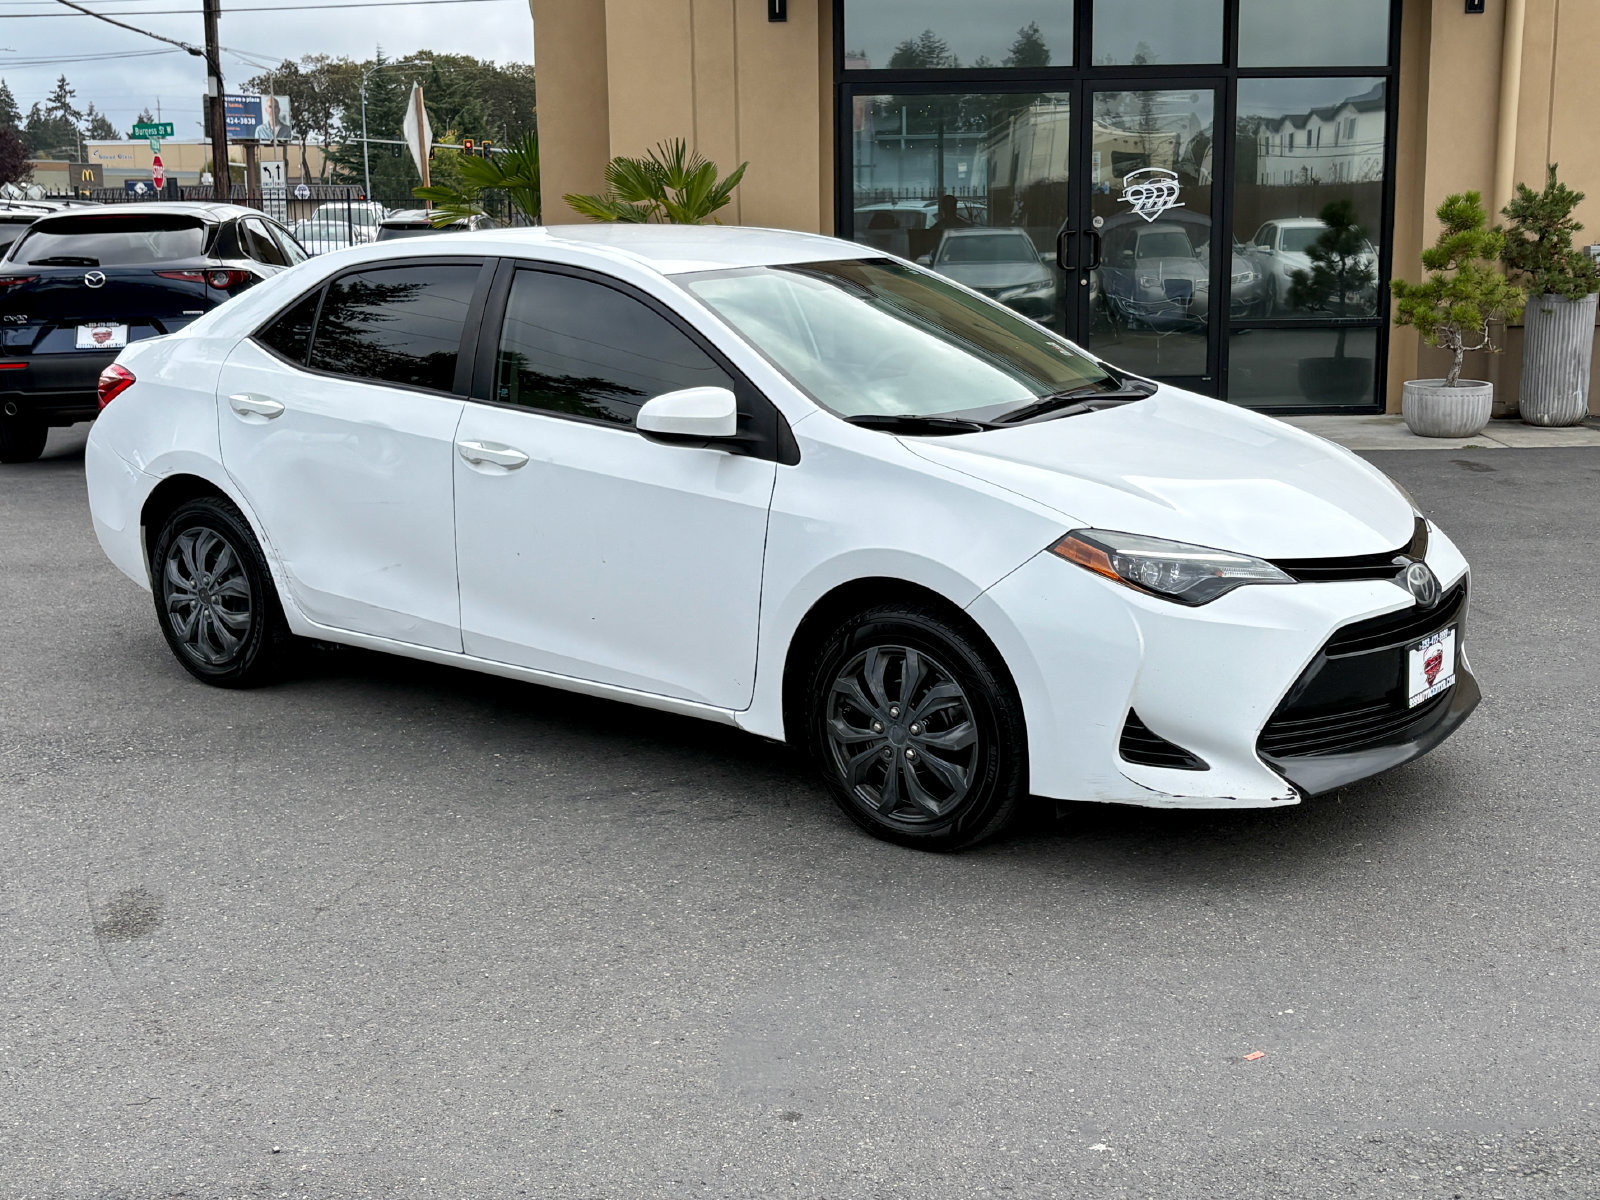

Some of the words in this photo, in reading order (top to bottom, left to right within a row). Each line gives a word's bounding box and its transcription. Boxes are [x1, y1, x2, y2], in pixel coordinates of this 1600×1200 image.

[134, 127, 158, 136] Burgess
[158, 126, 165, 134] St
[166, 125, 172, 134] W
[153, 165, 164, 178] STOP
